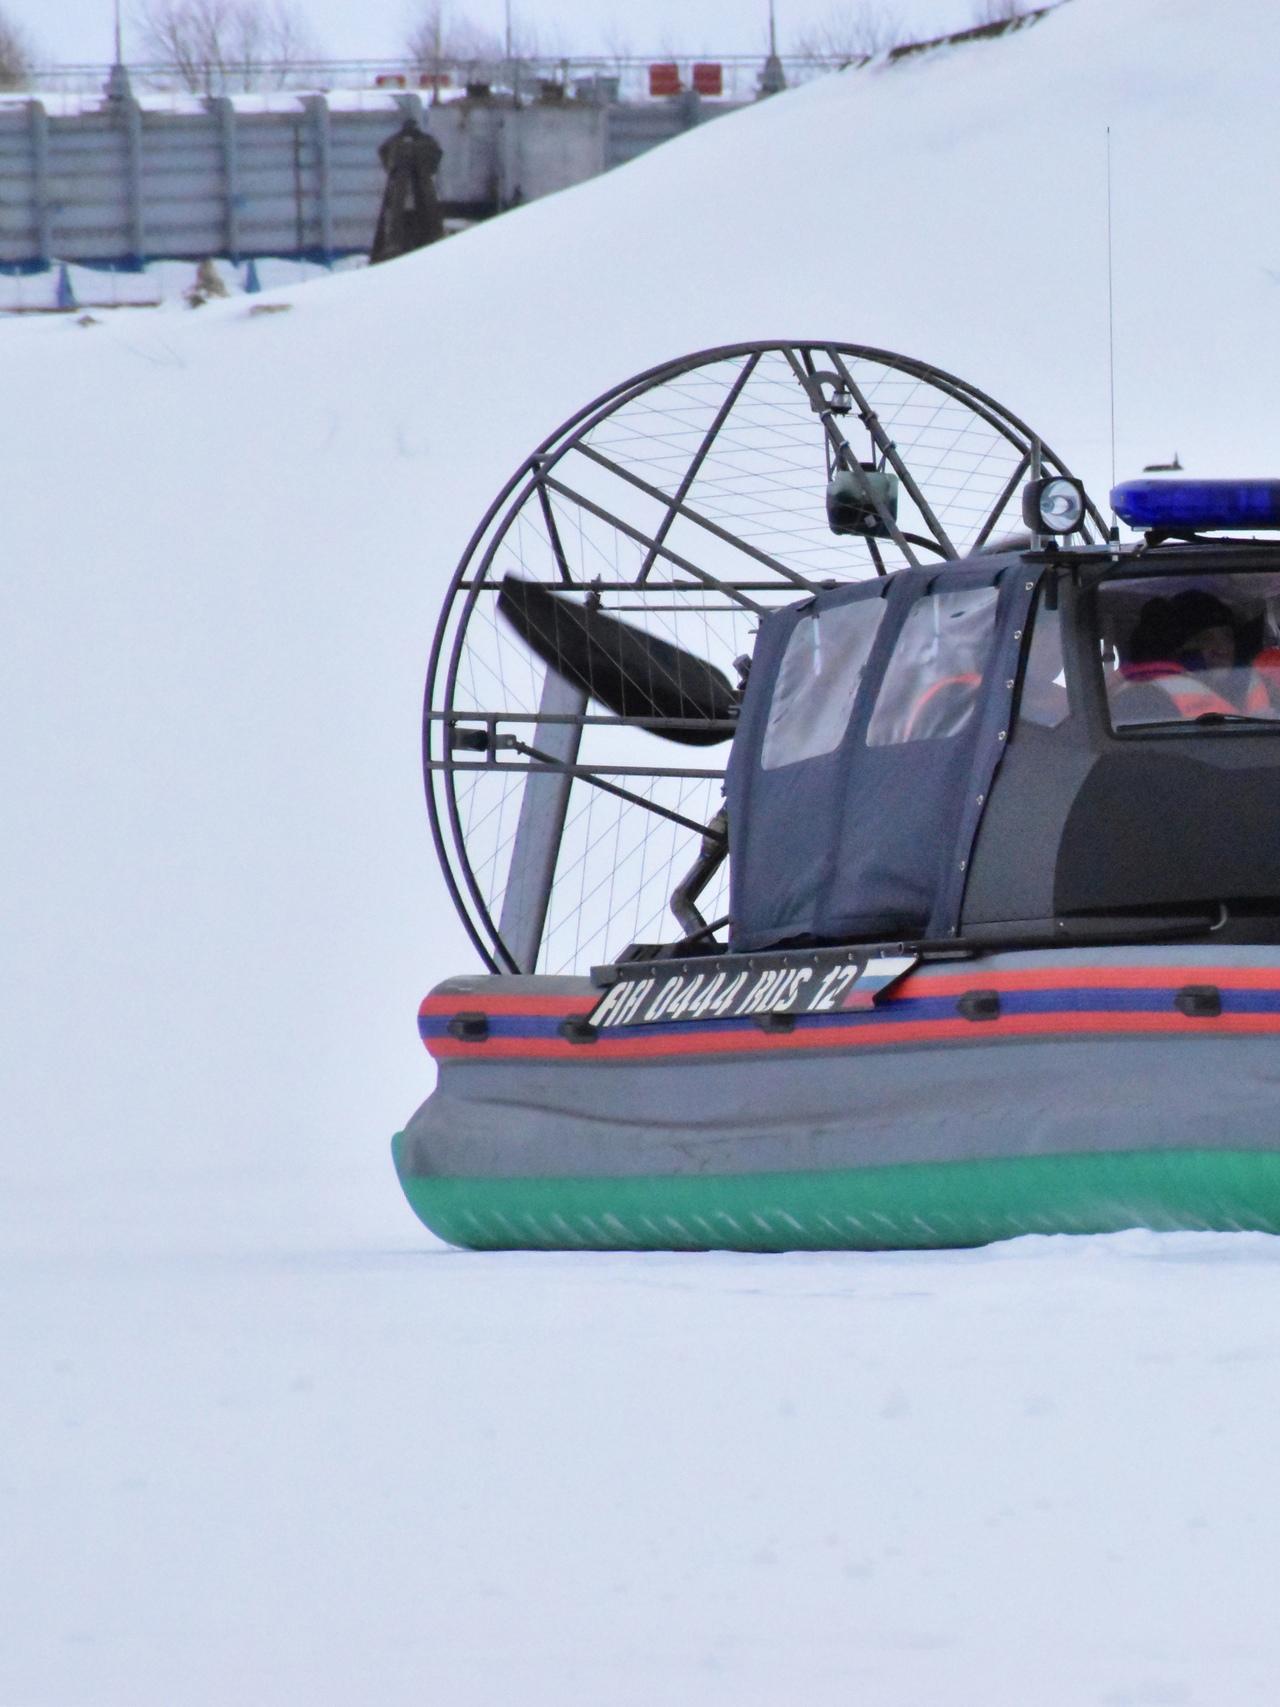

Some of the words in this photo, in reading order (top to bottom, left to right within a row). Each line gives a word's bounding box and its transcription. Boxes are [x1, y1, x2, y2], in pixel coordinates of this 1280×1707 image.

[644, 972, 748, 1020] 0444
[734, 967, 812, 1014] RUS
[807, 965, 858, 1010] 12
